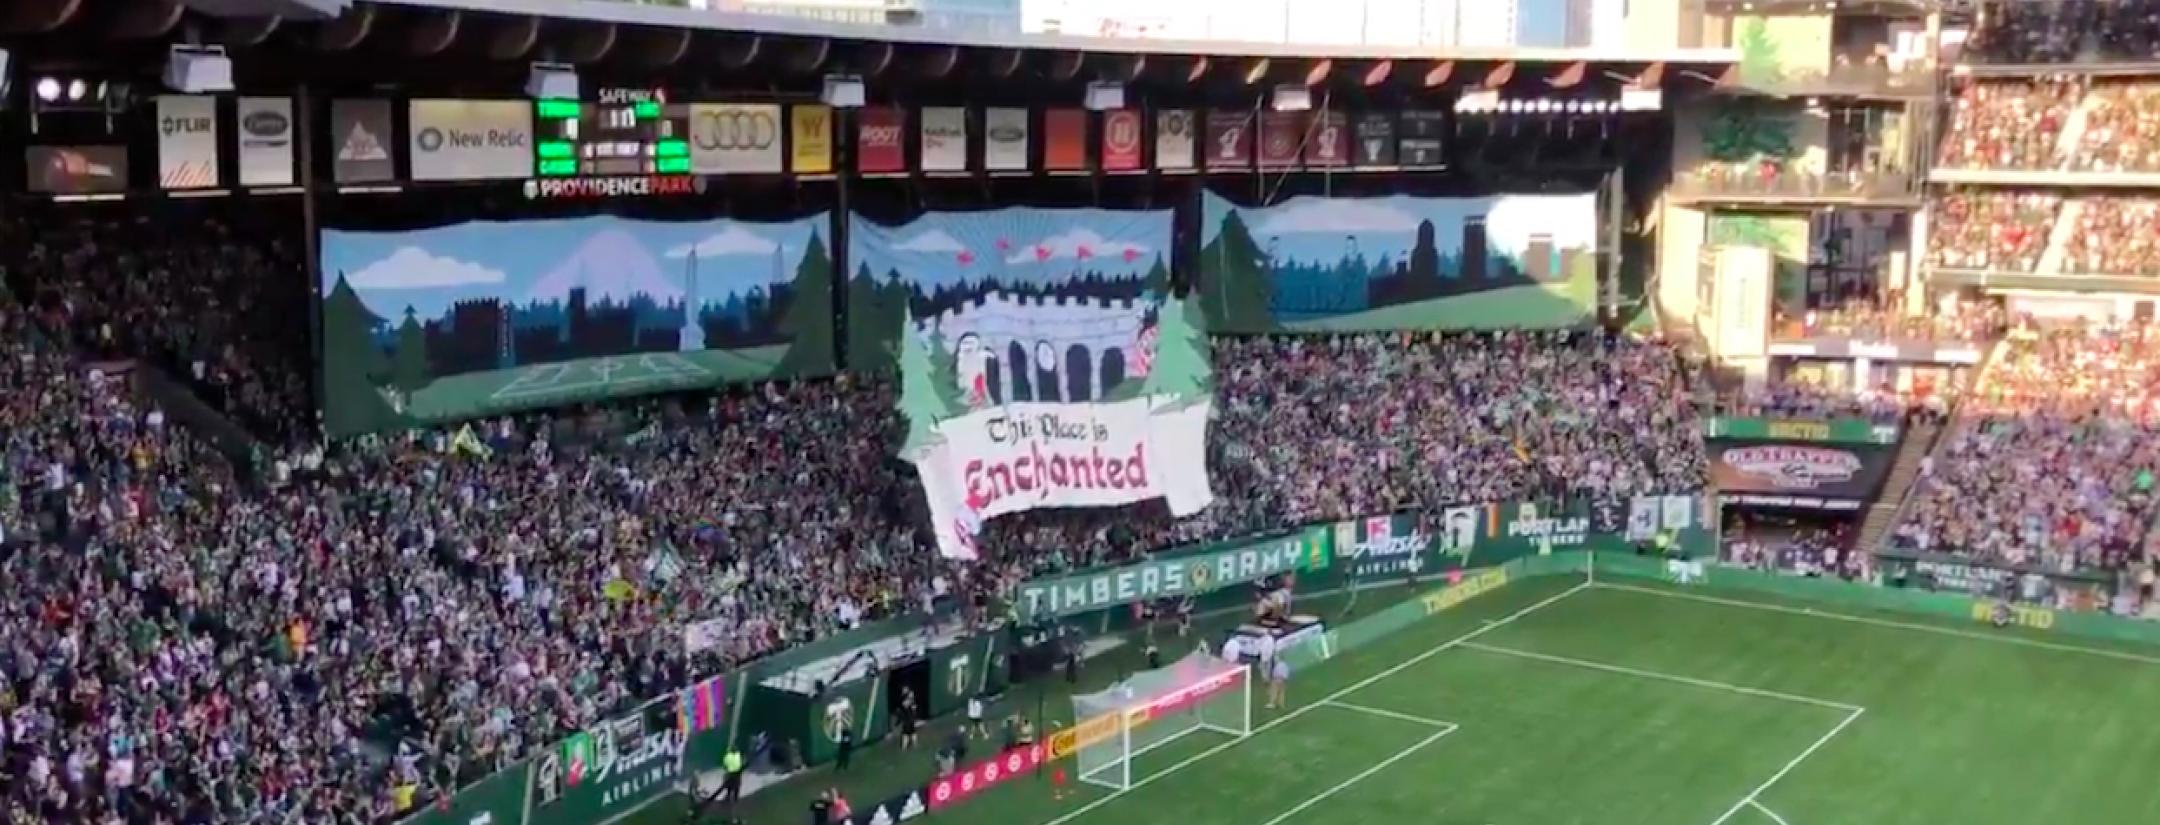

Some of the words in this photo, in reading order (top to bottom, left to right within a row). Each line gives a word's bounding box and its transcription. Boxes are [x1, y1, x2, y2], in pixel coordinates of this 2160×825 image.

[598, 87, 653, 104] SAFEWAY
[175, 117, 211, 134] FLIR
[859, 125, 901, 145] ROOT
[448, 128, 487, 147] New
[492, 127, 525, 147] Relic
[1037, 412, 1087, 444] Place
[1091, 416, 1109, 443] is
[964, 440, 1148, 509] Enchanted
[1024, 561, 1185, 617] TIMBERS
[1217, 541, 1301, 584] ARMY
